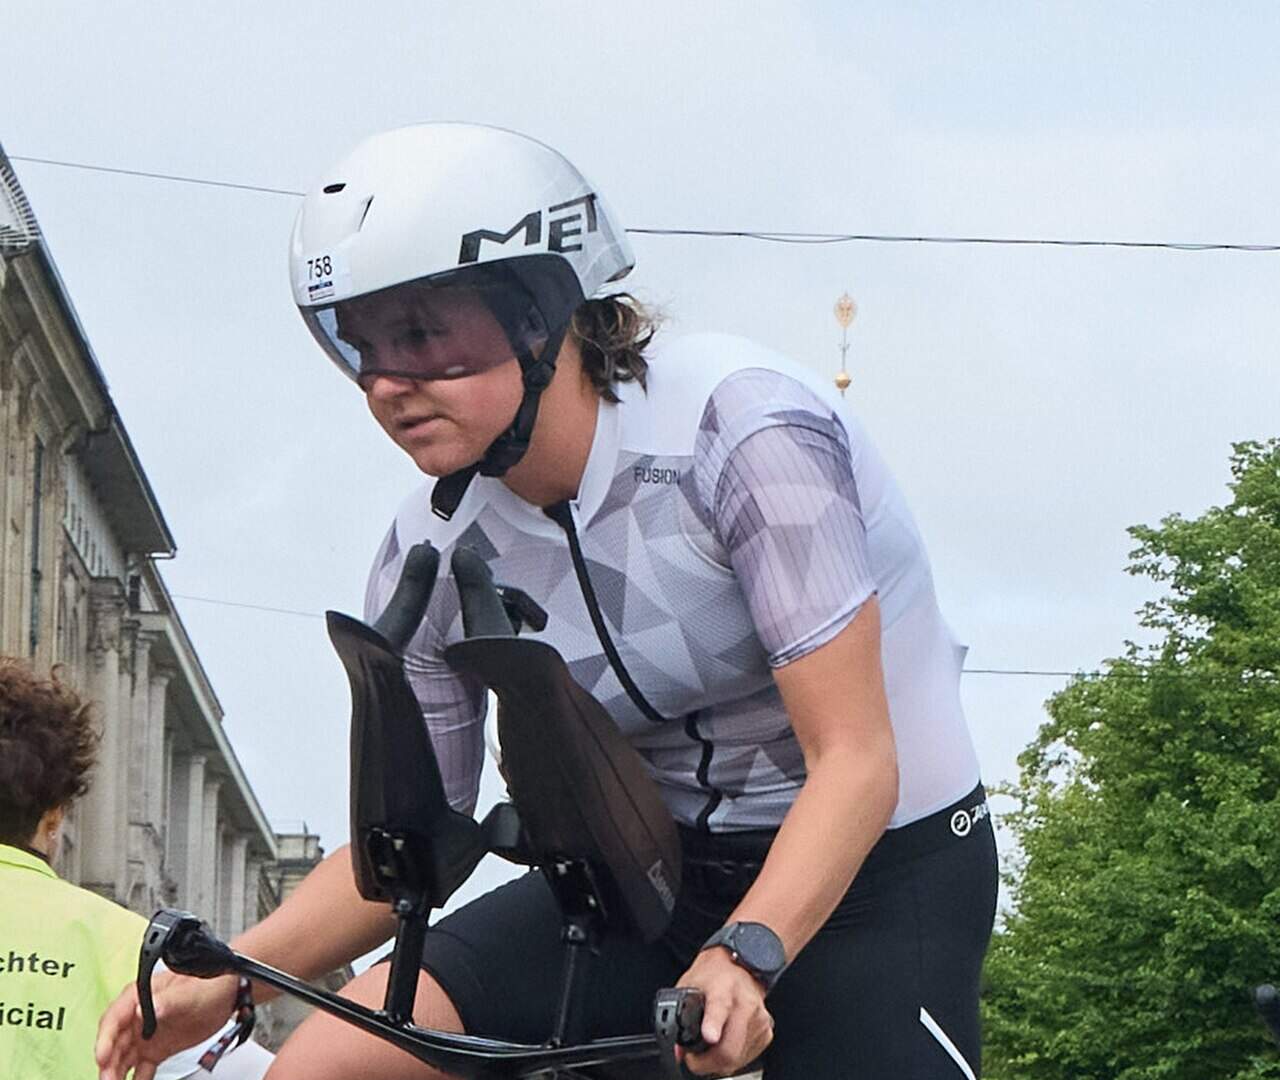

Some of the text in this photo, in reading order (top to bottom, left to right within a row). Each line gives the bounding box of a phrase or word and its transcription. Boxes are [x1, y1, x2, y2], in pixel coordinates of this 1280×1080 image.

[458, 193, 597, 265] MET
[306, 256, 332, 281] 758
[633, 466, 681, 486] FUSION
